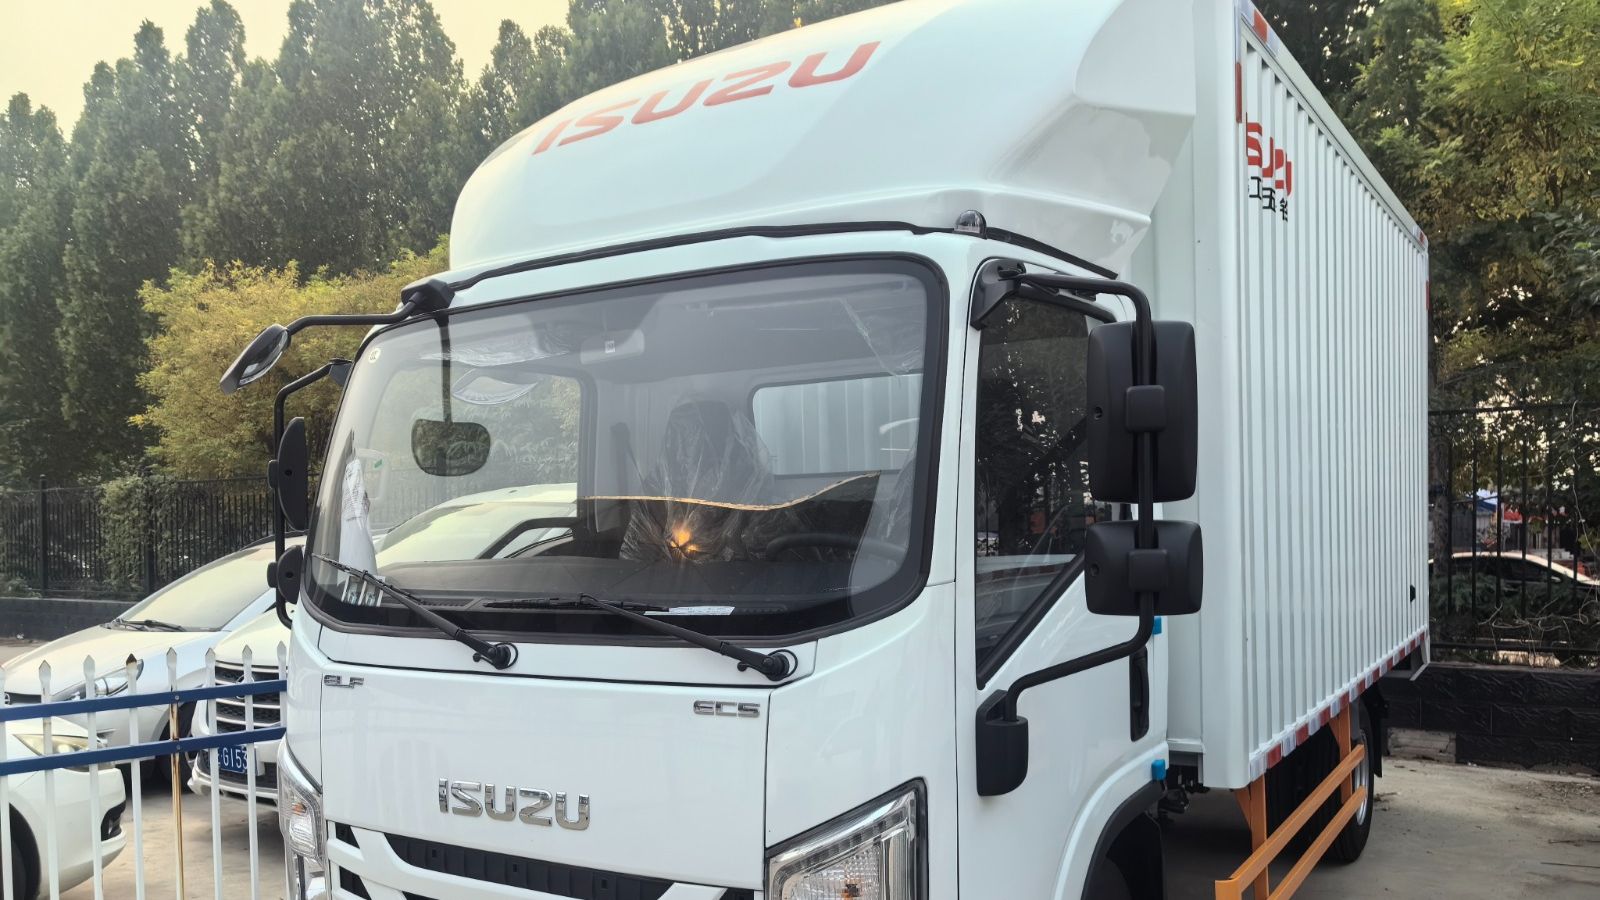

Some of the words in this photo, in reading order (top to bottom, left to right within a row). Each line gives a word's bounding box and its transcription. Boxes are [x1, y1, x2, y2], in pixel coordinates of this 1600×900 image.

[532, 40, 881, 156] ISUZU
[693, 700, 761, 718] ECS
[438, 777, 591, 831] ISUZU
